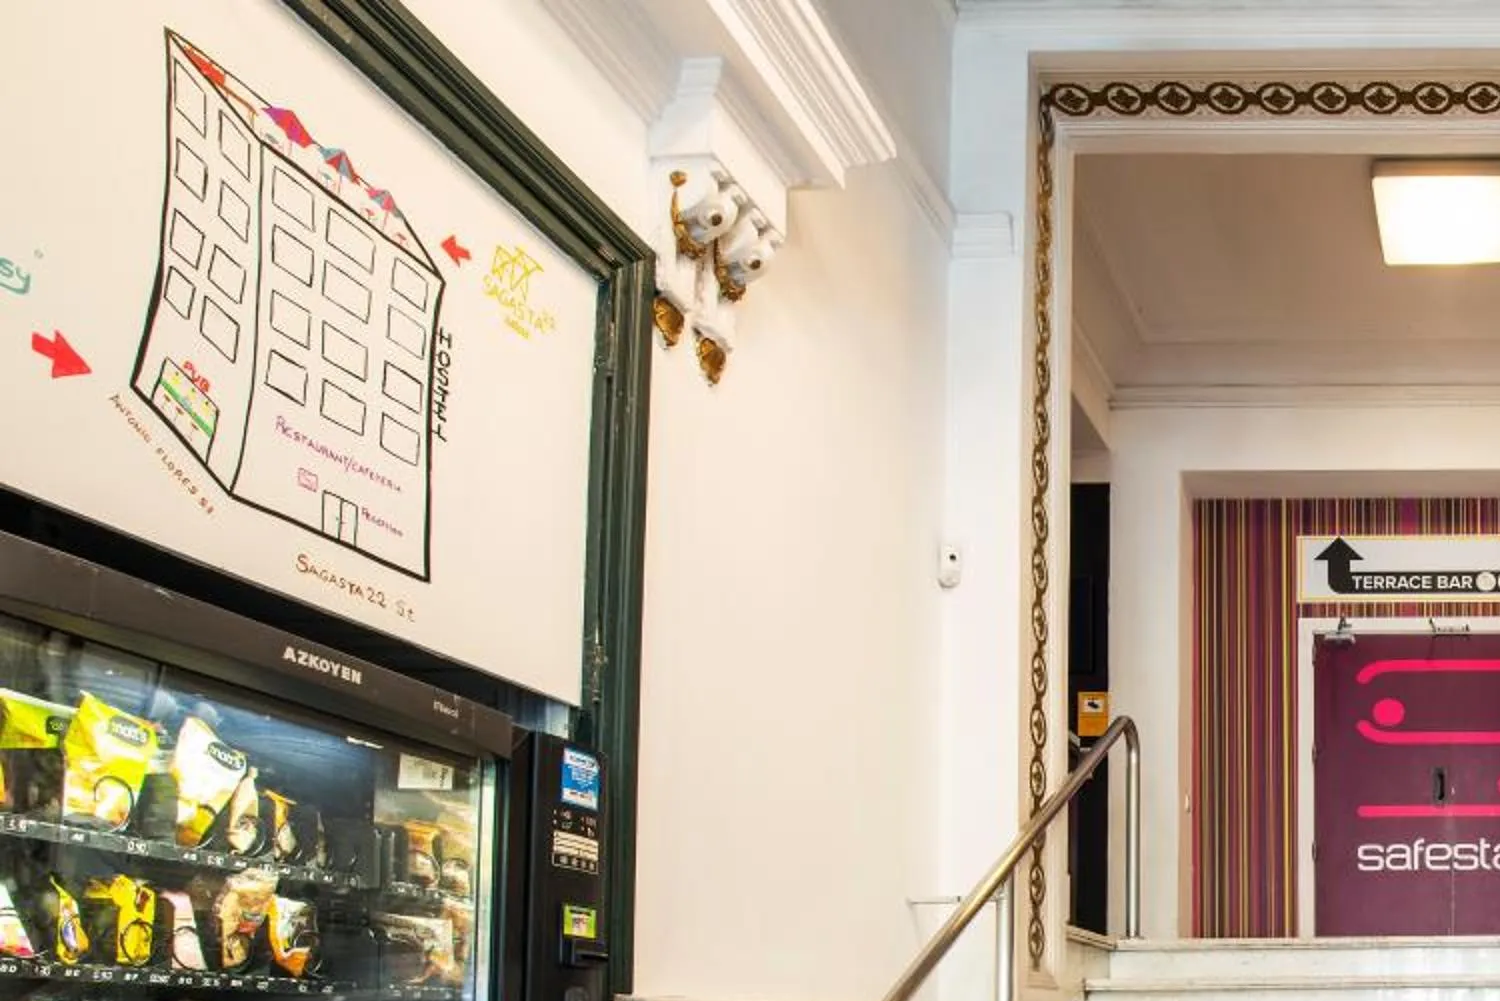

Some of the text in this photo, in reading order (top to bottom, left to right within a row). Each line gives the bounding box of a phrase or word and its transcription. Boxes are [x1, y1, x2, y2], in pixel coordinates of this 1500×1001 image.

[183, 360, 210, 392] PUB
[431, 327, 453, 442] HOSTEL
[367, 586, 386, 608] 22
[1351, 574, 1473, 590] TERRACE BAR
[283, 646, 363, 685] AZKOYEN
